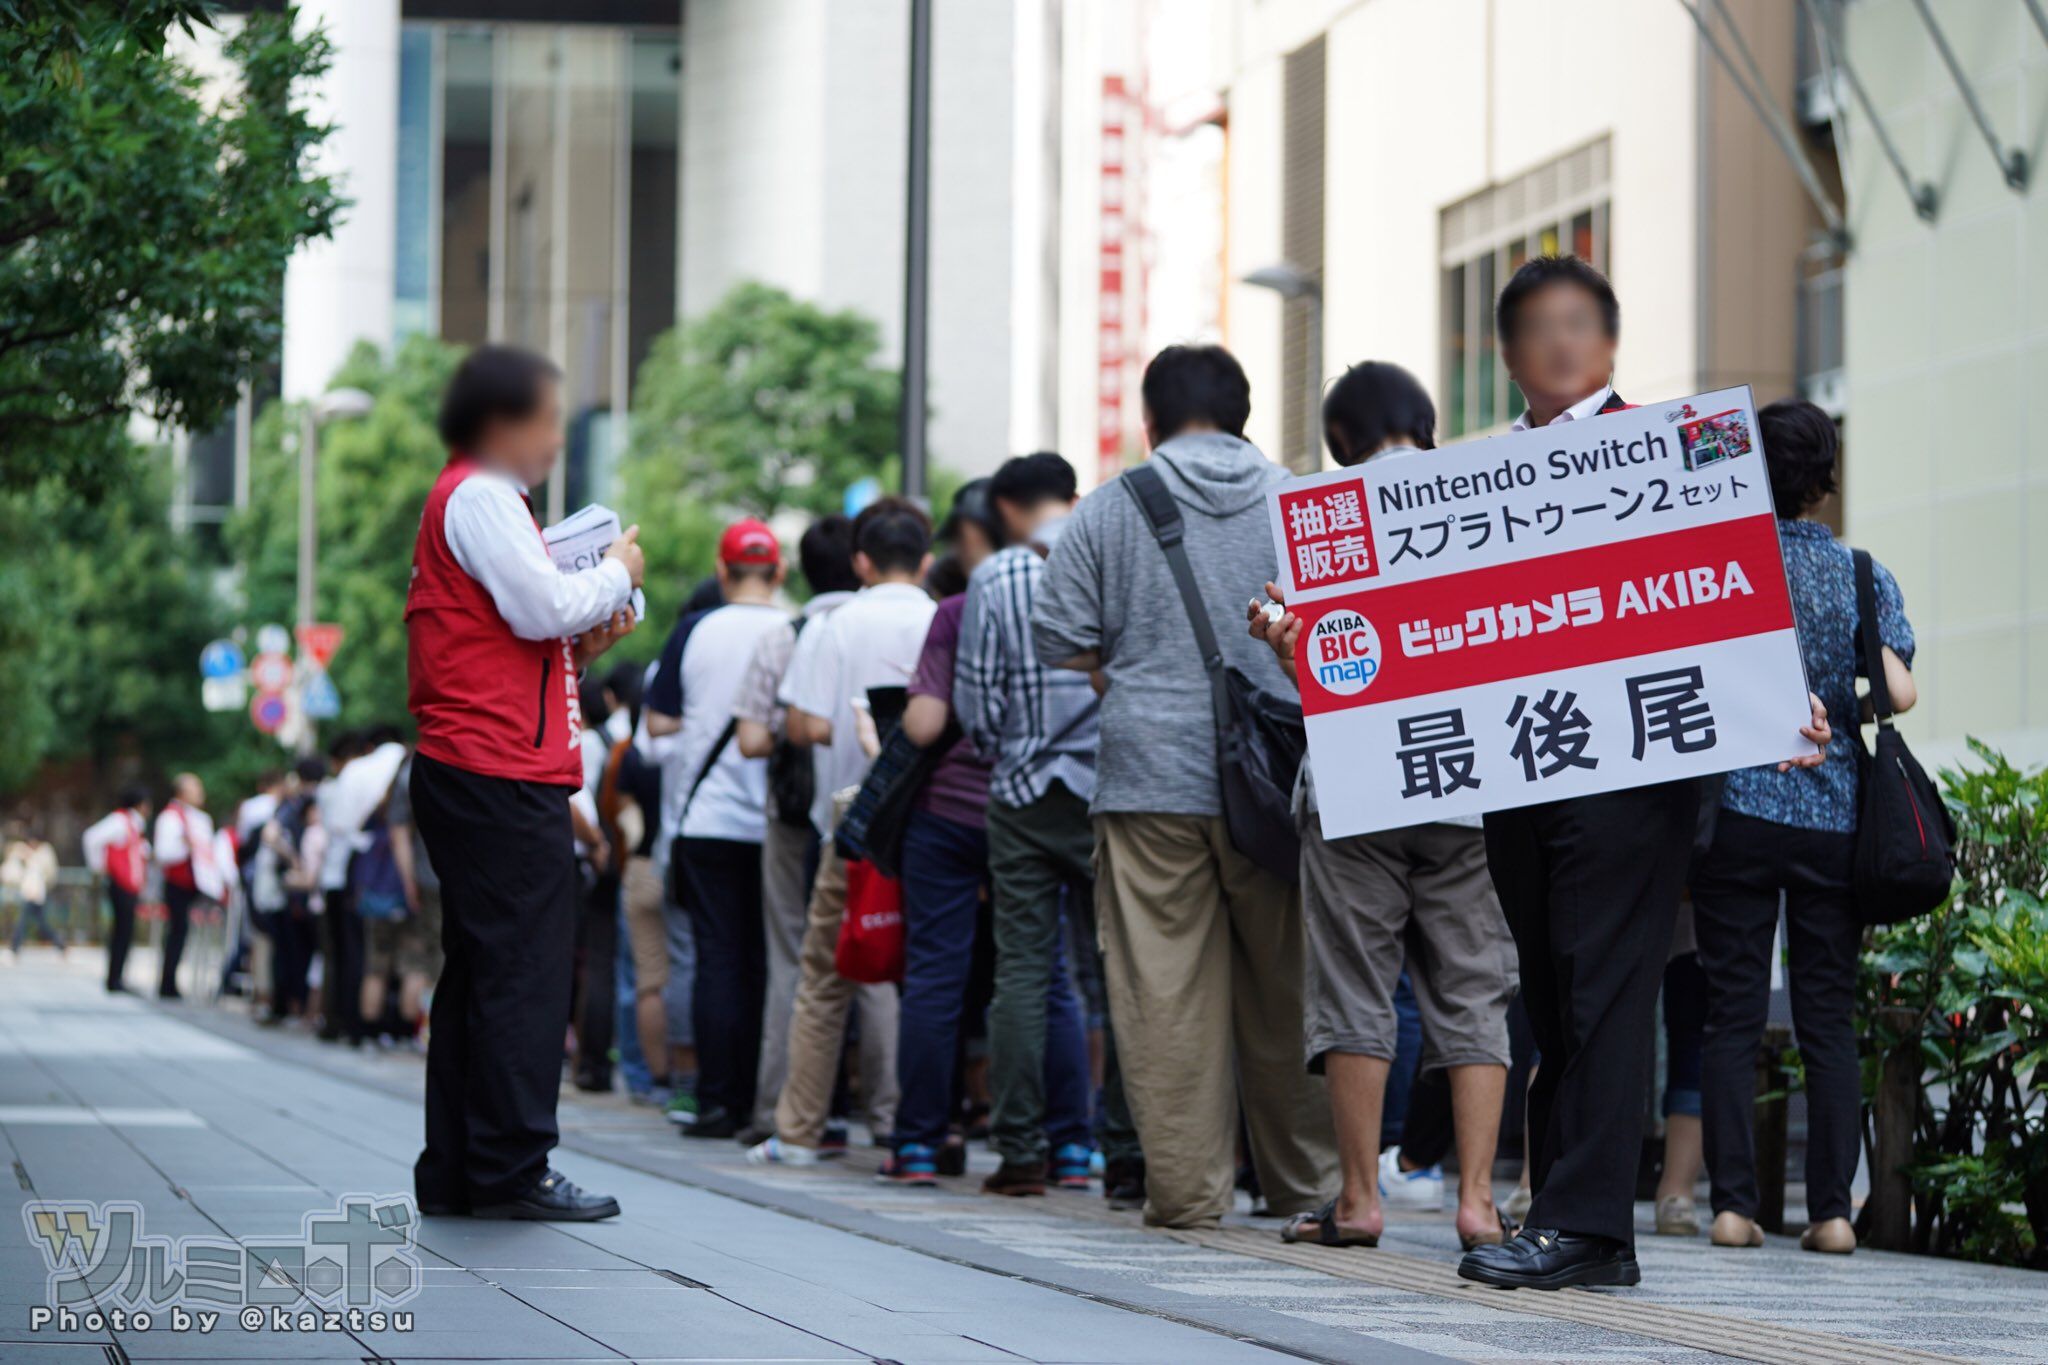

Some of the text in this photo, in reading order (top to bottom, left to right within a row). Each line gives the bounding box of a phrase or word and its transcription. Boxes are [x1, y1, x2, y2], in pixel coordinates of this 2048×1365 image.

[1378, 431, 1667, 514] Nintendo Switch
[1289, 490, 1364, 541] 抽選
[1296, 535, 1370, 584] 販売
[1316, 616, 1364, 635] AKIBA
[1399, 560, 1754, 658] ビックカメラ AKIBA
[1319, 631, 1369, 663] BIC
[1320, 658, 1377, 684] map
[1396, 665, 1717, 799] 最後尾
